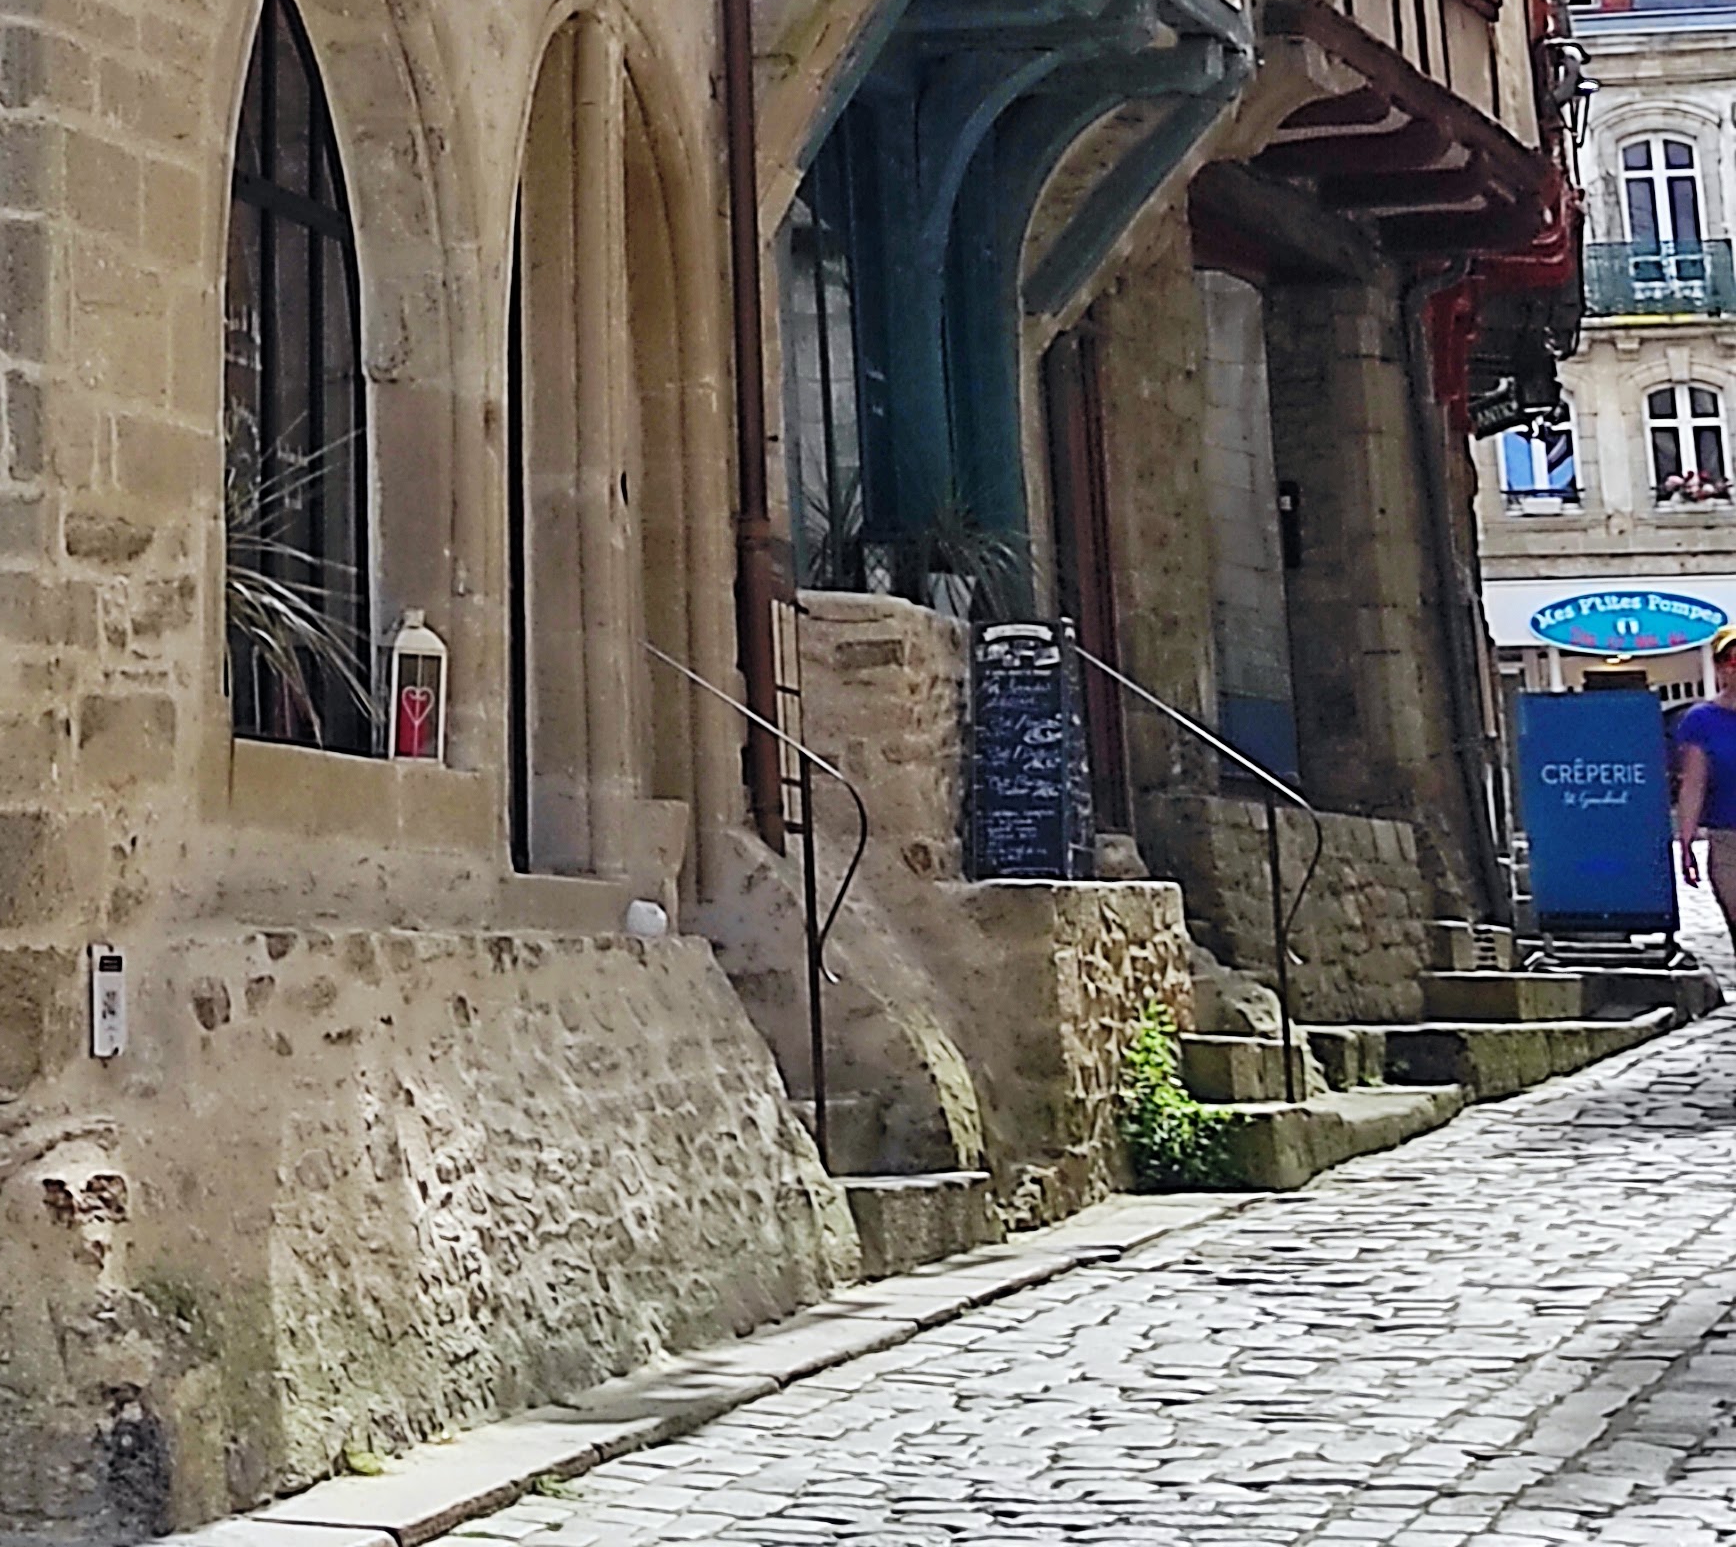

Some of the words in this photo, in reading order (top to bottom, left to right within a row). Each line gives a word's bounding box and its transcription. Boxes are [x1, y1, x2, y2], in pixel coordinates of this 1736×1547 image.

[1535, 603, 1576, 631] Mes
[1578, 593, 1643, 616] P'tites
[1647, 593, 1724, 625] Pompes
[1540, 757, 1647, 785] CRÊPERIE
